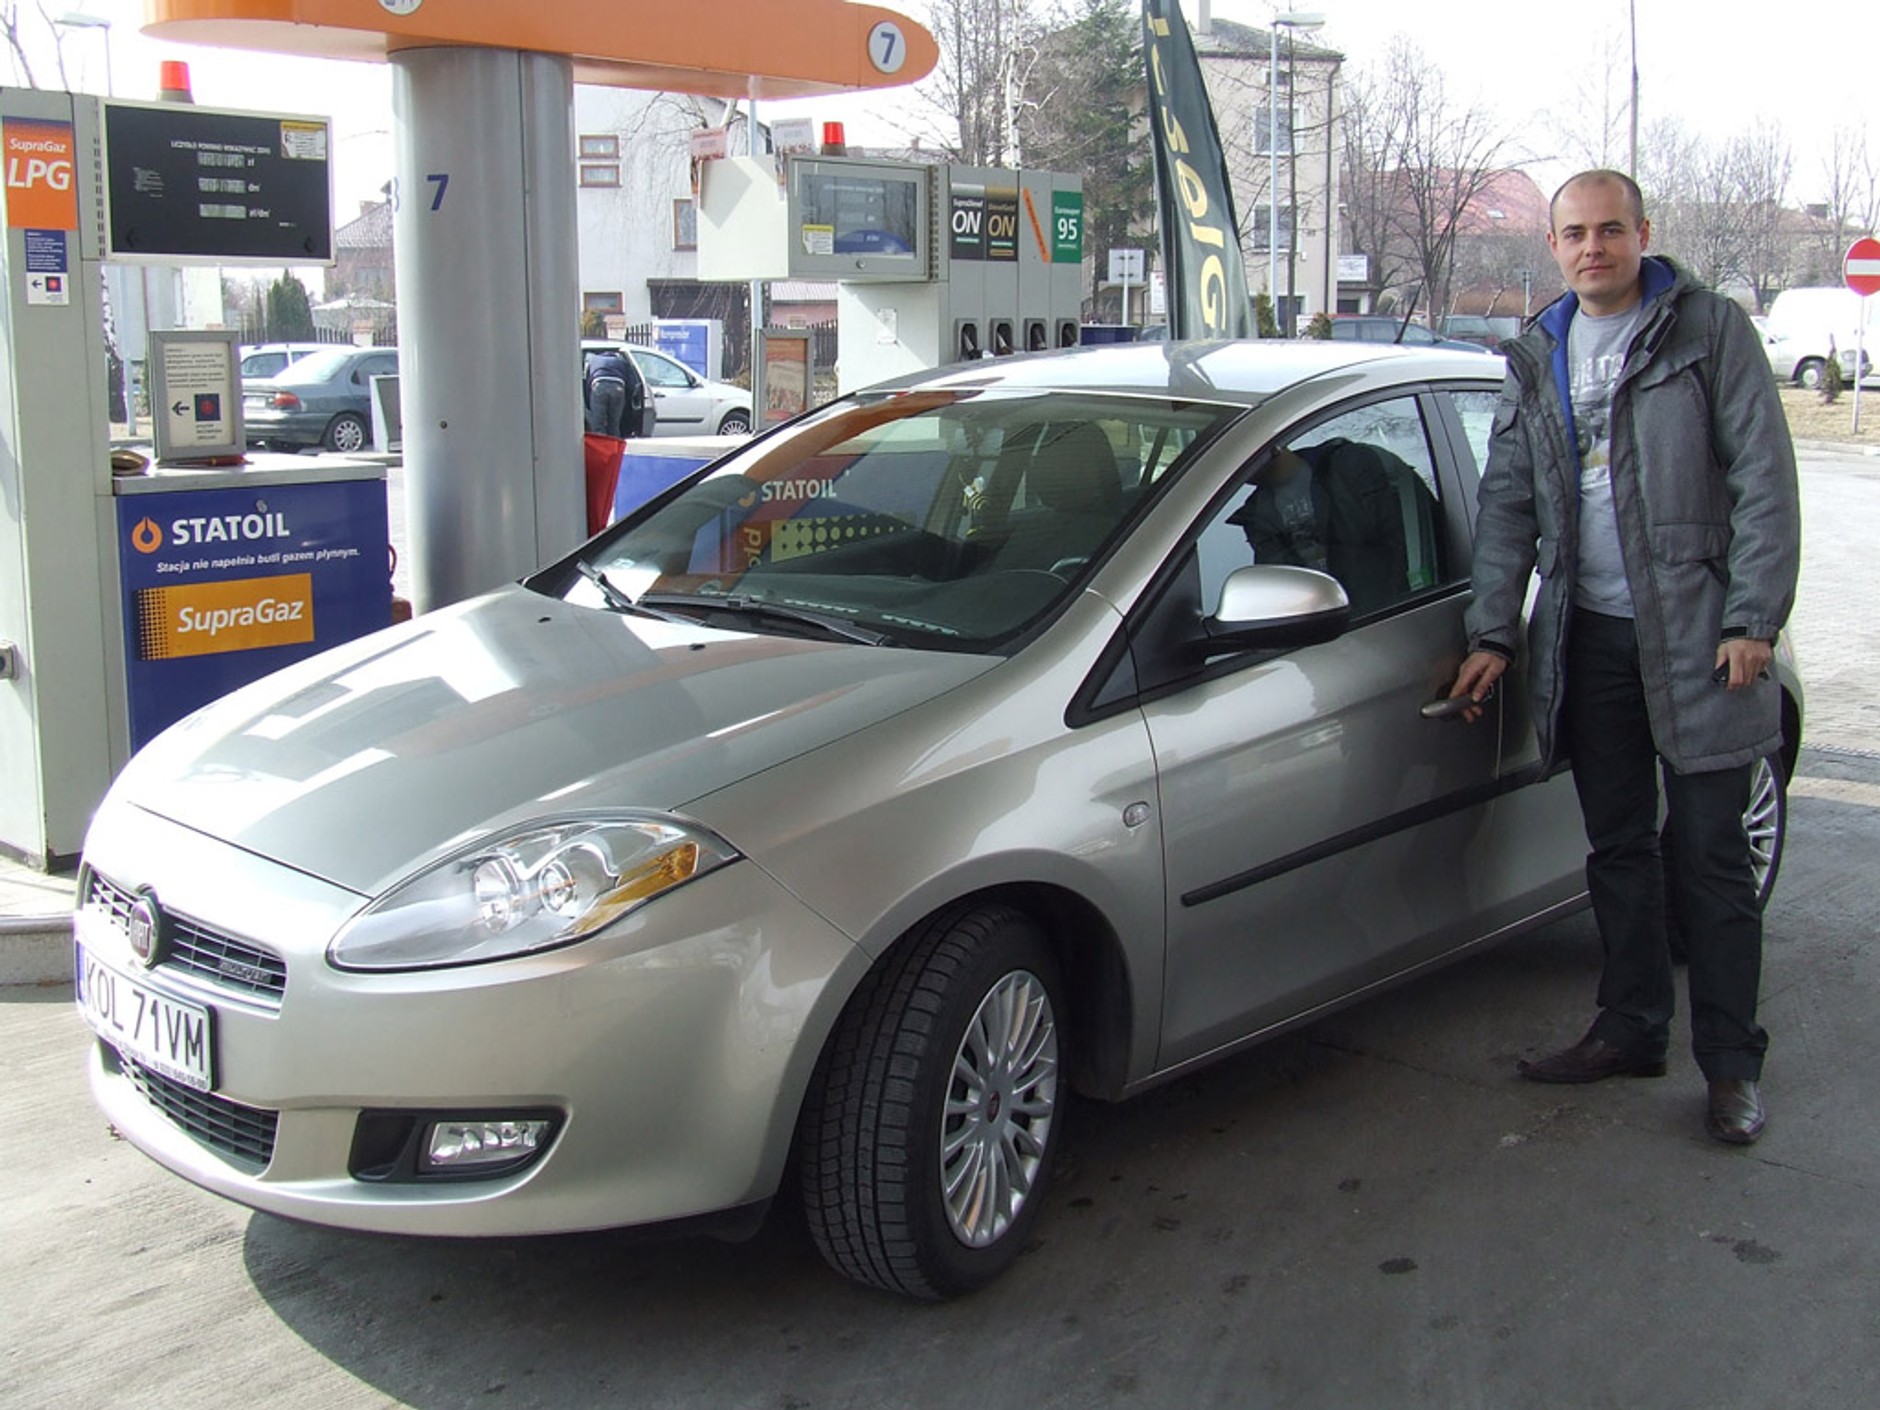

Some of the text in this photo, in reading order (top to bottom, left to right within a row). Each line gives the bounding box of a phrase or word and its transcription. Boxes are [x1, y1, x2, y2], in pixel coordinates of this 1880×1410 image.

[880, 31, 896, 64] 7
[9, 137, 67, 154] SupraGaz
[7, 157, 72, 191] LPG
[426, 174, 449, 211] 7
[952, 210, 982, 235] ON
[987, 214, 1015, 237] ON
[1057, 217, 1079, 240] 95
[761, 478, 838, 502] STATOIL
[171, 512, 291, 546] STATOIL
[155, 561, 191, 574] Stacja
[192, 558, 210, 570] nie
[282, 550, 315, 564] gazem
[176, 597, 305, 637] SupraGaz
[86, 956, 125, 1032] KOL
[132, 988, 204, 1073] 71VM
